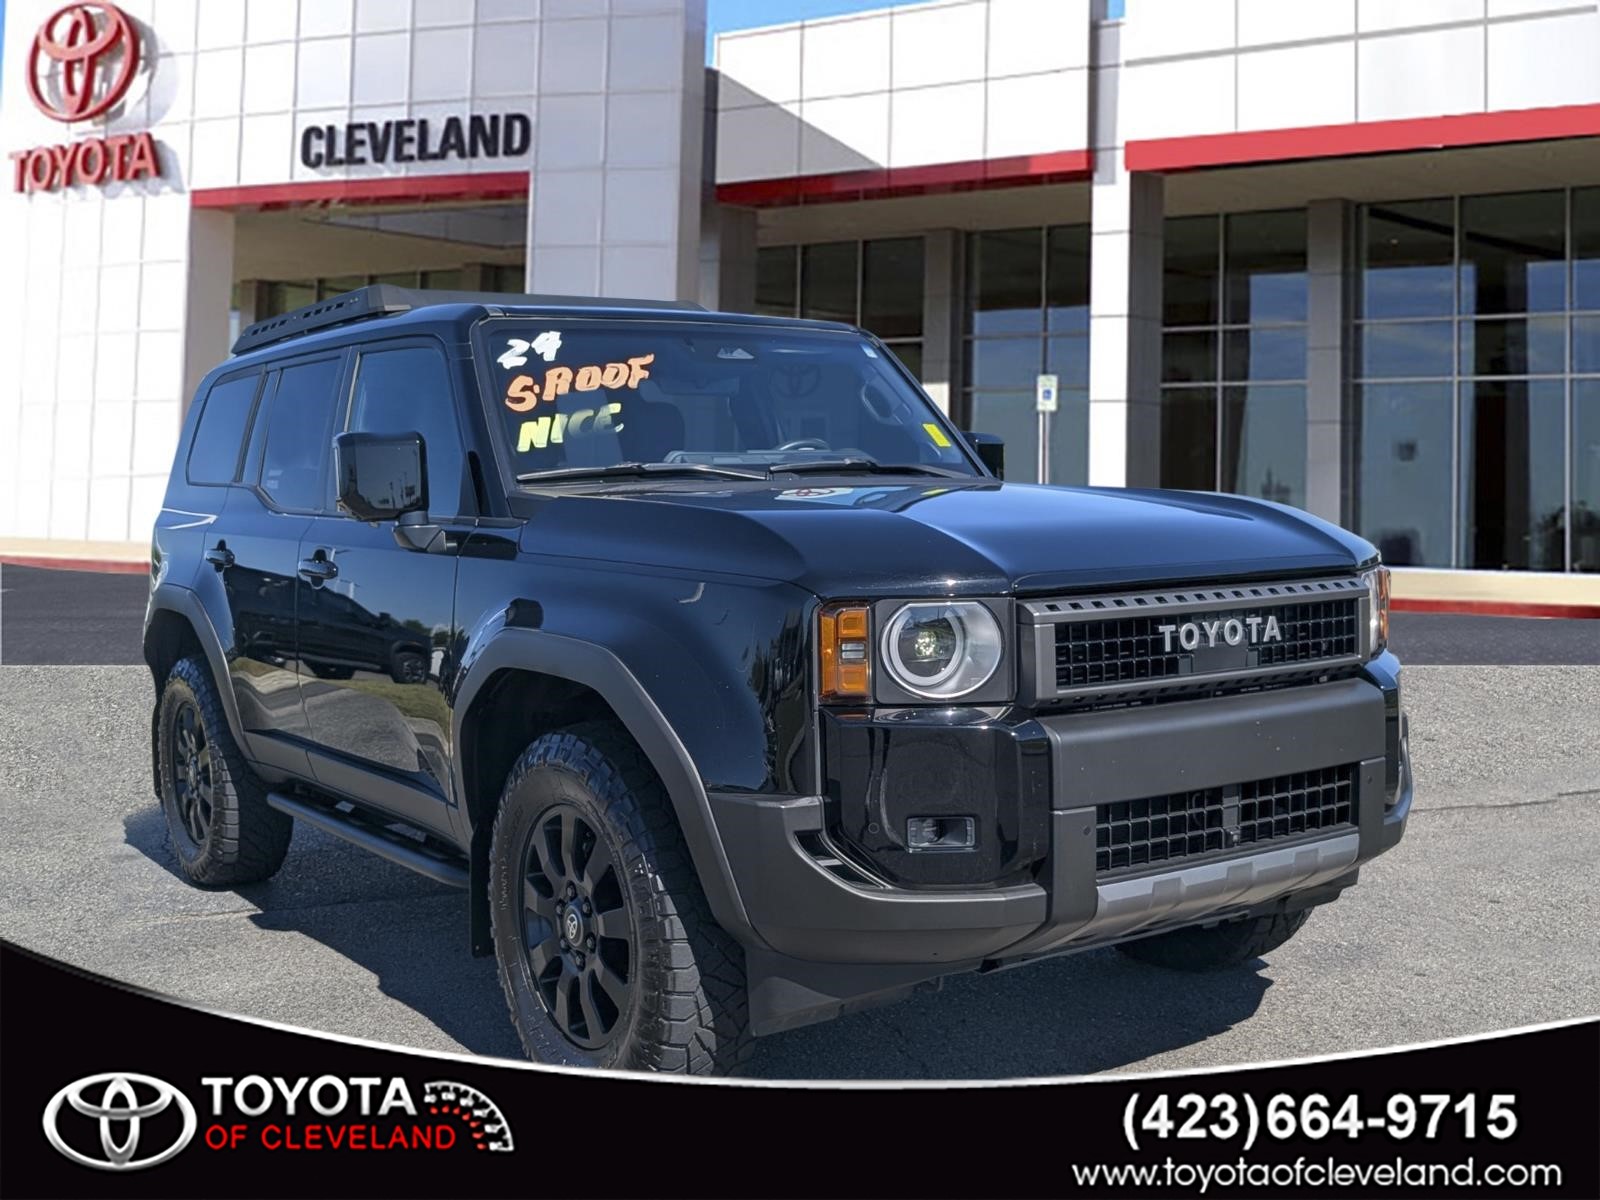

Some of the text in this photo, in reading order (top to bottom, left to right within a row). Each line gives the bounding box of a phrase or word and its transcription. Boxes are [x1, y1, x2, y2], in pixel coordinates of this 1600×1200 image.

[9, 131, 161, 193] TOYOTA
[300, 113, 531, 169] CLEVELAND
[1158, 615, 1282, 652] TOYOTA
